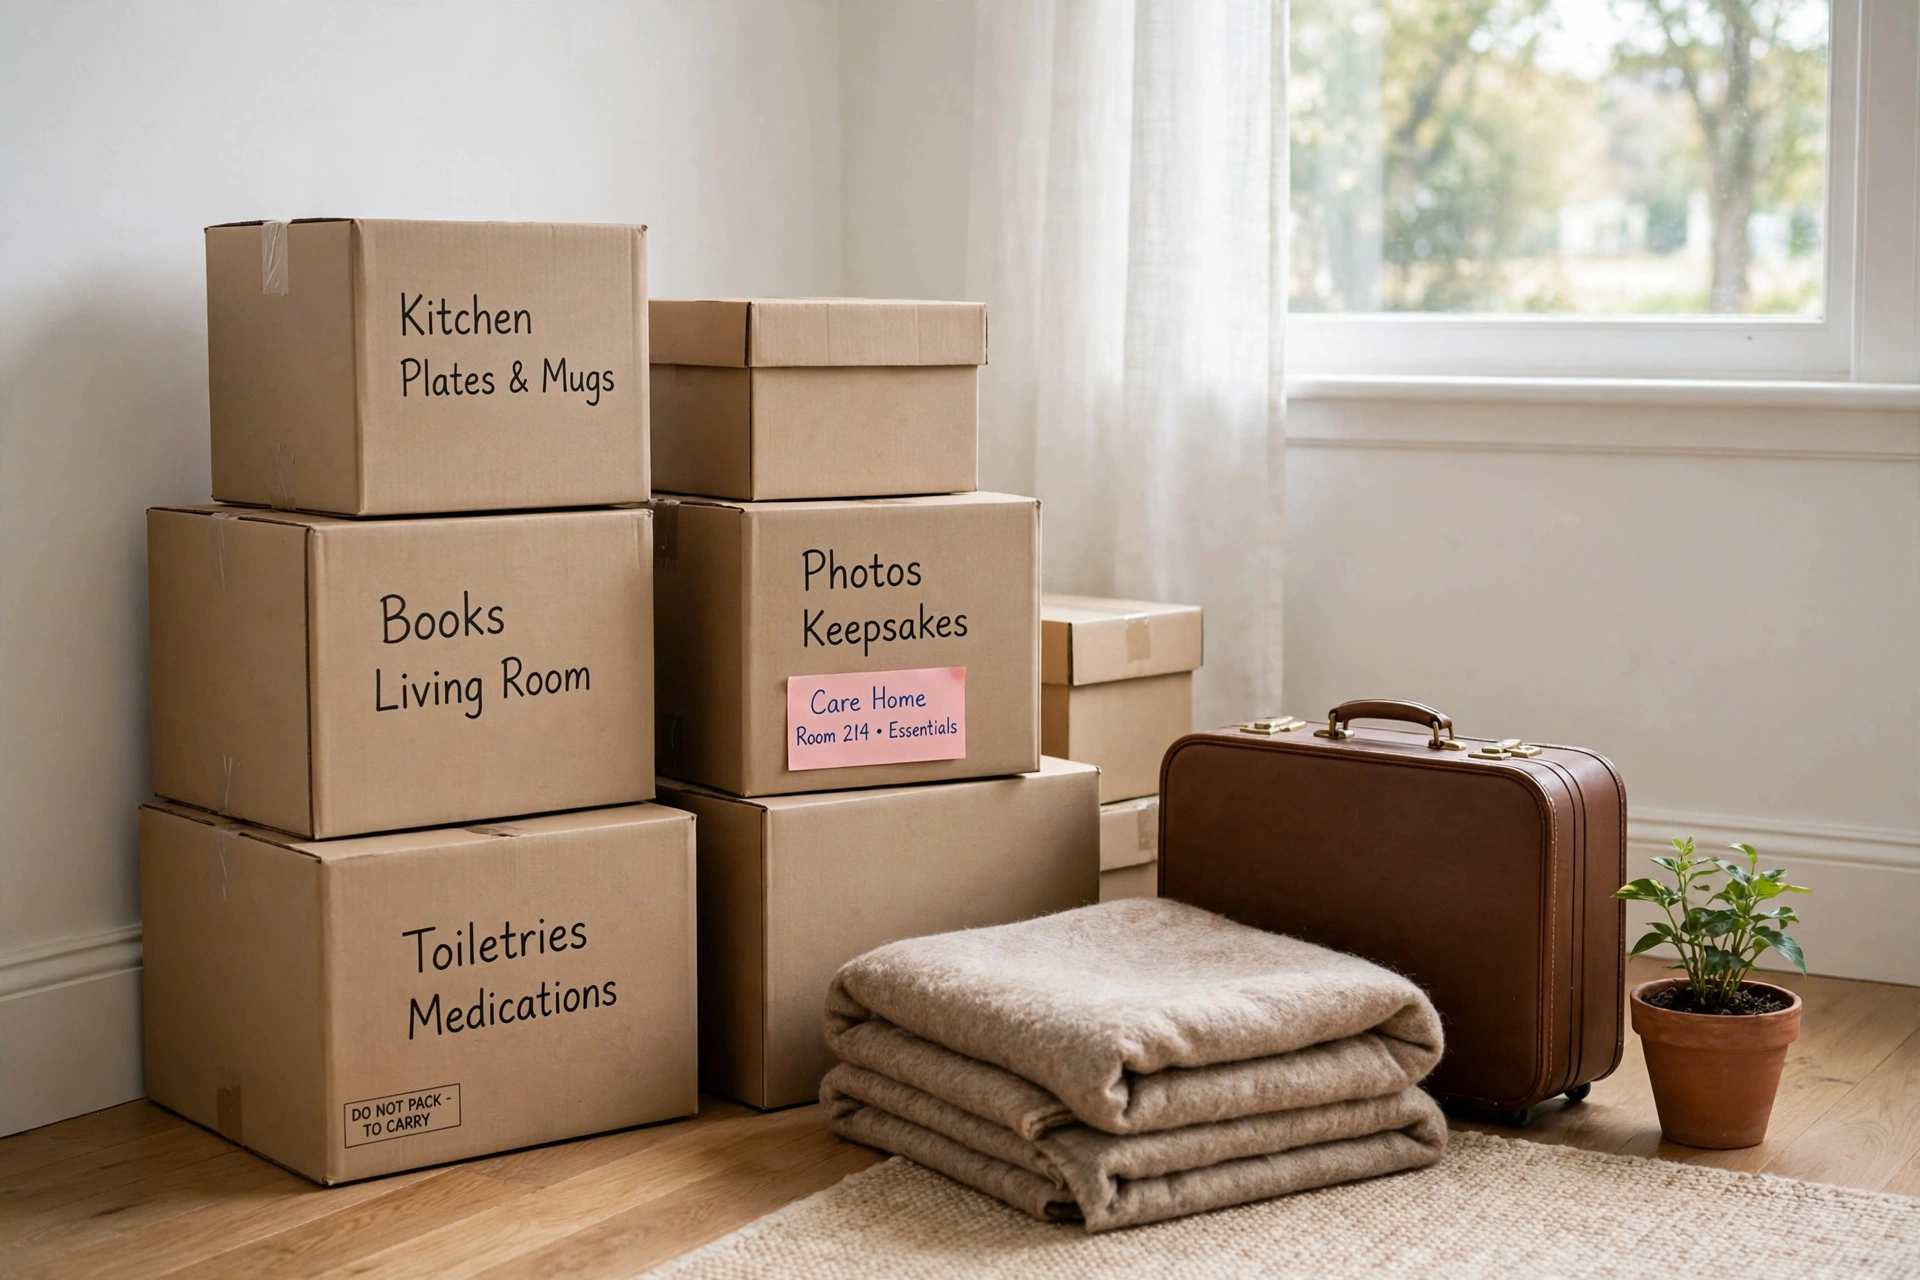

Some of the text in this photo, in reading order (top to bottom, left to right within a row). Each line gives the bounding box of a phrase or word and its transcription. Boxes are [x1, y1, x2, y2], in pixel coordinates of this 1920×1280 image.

[400, 291, 531, 336] Kitchen
[400, 357, 614, 406] Plates & Mugs
[801, 548, 921, 591] Photos
[379, 590, 504, 644] Books
[803, 602, 967, 657] Keepsakes
[375, 656, 590, 719] Living Room
[810, 685, 926, 714] Care Home
[796, 725, 835, 745] Room
[843, 722, 869, 742] 214
[889, 716, 957, 738] Essentials
[401, 918, 586, 973] Toiletries
[408, 980, 616, 1040] Medications
[351, 1106, 371, 1121] DO
[375, 1099, 403, 1117] NOT
[408, 1093, 441, 1111] PACK
[362, 1112, 430, 1137] TO CARRY
